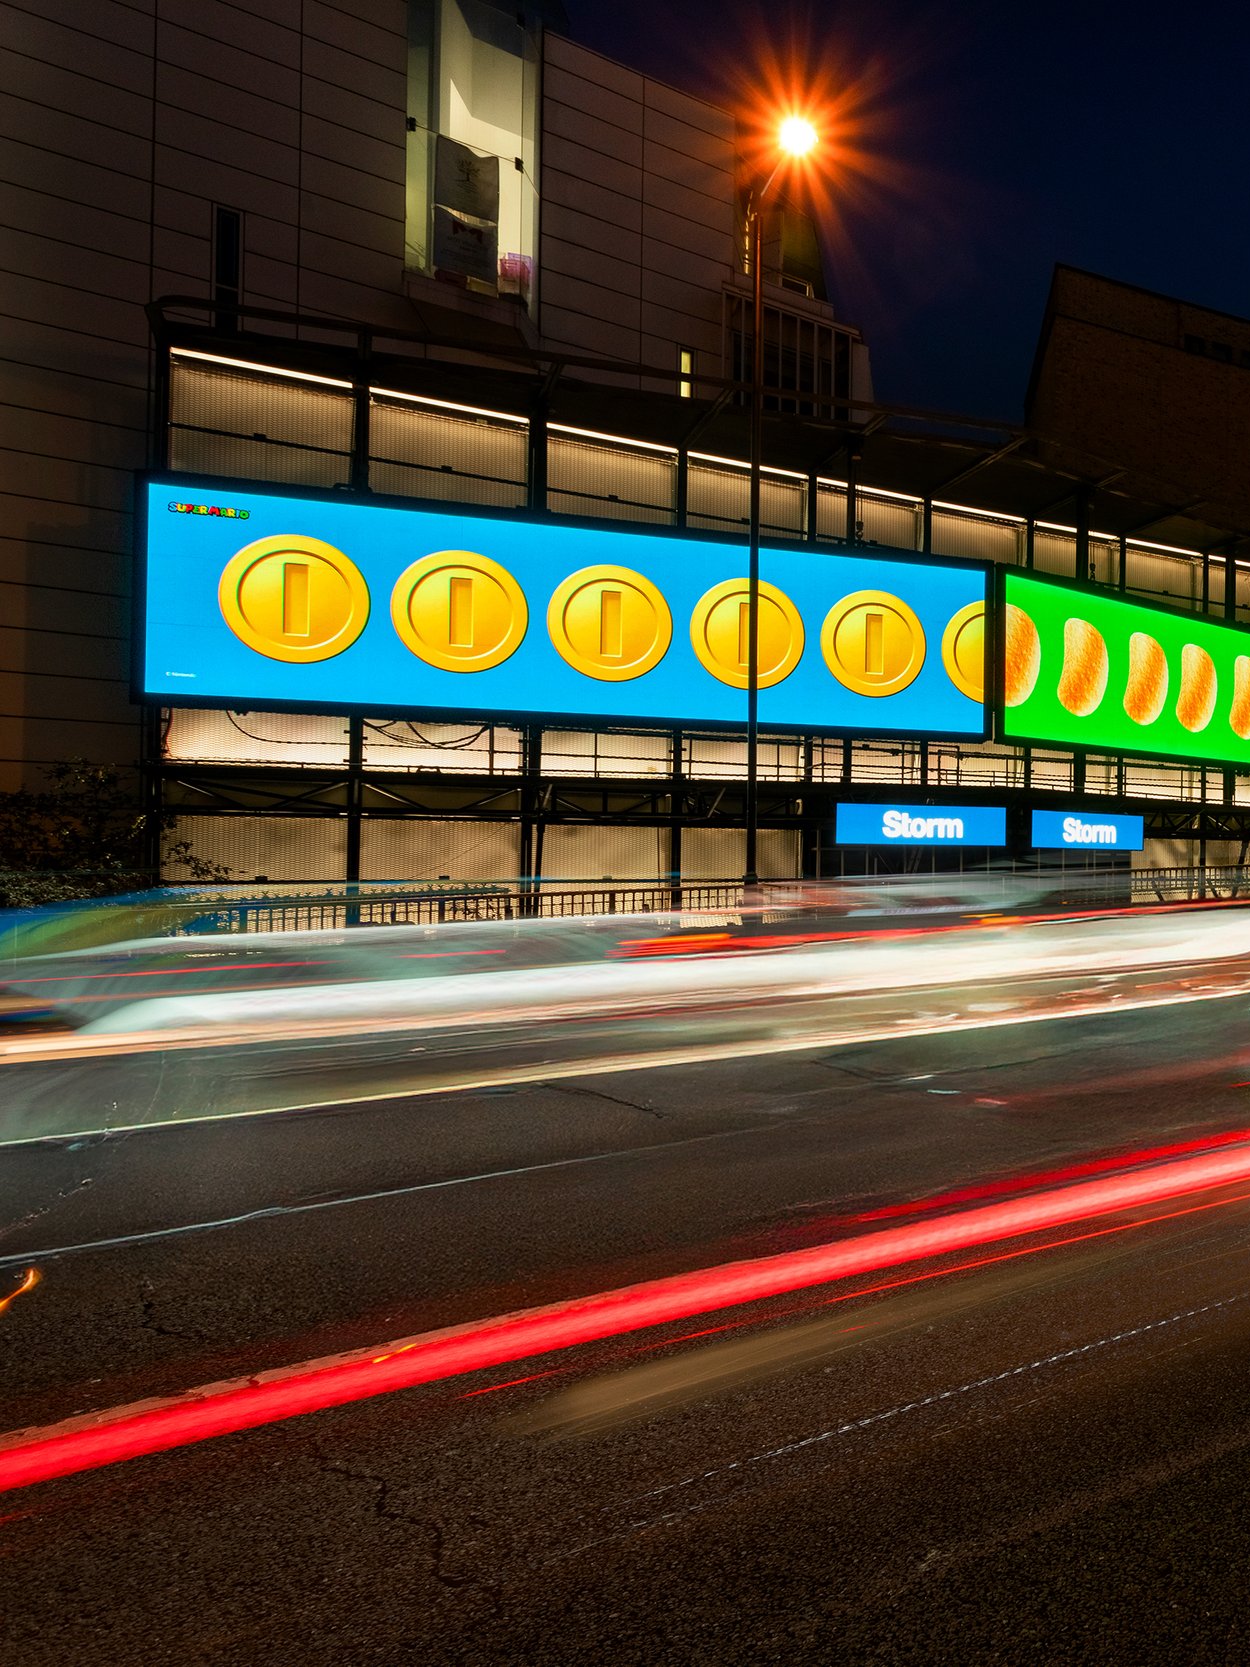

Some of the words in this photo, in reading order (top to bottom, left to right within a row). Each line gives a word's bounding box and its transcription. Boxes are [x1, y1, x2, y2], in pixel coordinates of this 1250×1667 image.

[168, 501, 208, 515] SUPER
[208, 506, 250, 520] MARIO
[882, 810, 964, 838] Storm
[1063, 817, 1117, 844] Storm
